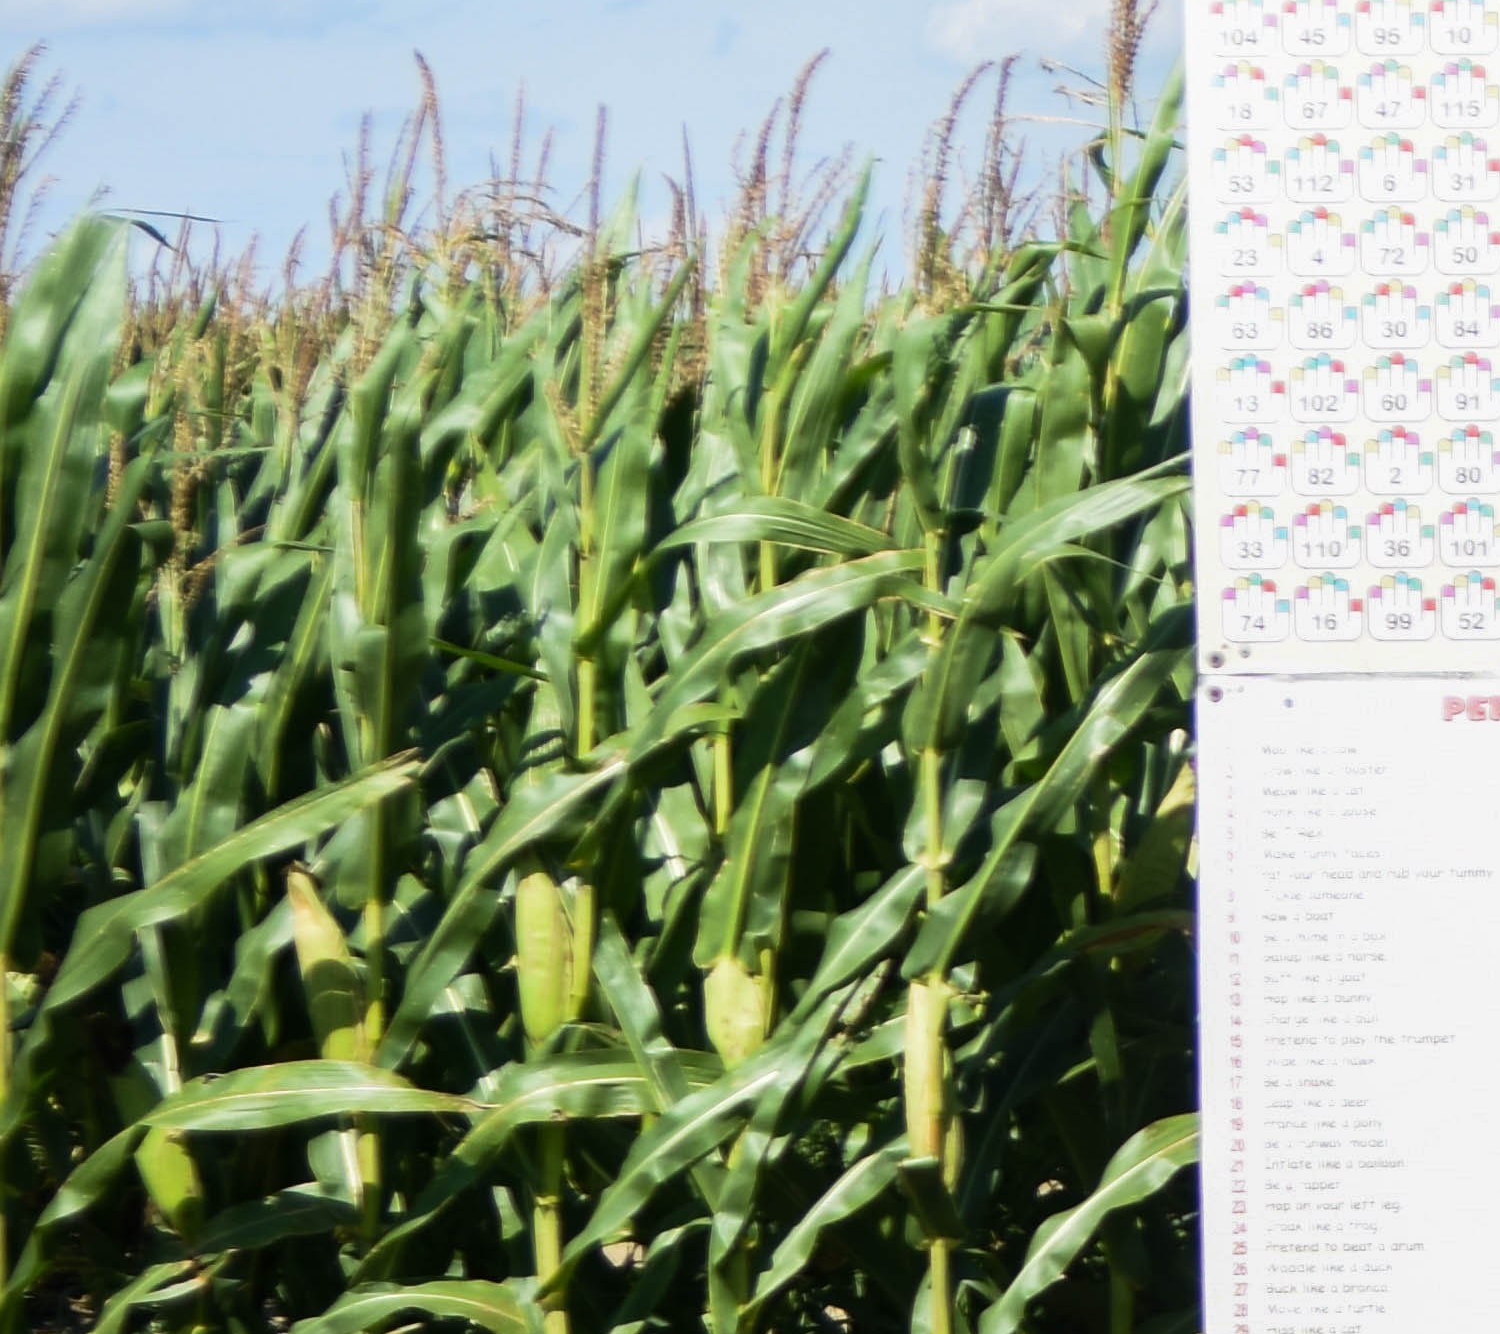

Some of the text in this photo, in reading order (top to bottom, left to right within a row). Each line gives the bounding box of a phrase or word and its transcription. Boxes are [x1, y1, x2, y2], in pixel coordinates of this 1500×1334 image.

[1230, 175, 1254, 193] 53
[1294, 175, 1333, 192] 112
[1383, 175, 1396, 192] 6
[1451, 173, 1474, 191] 31
[1234, 395, 1259, 412] 13
[1300, 395, 1338, 412] 102
[1382, 395, 1407, 411] 60
[1456, 393, 1479, 410] 91
[1241, 615, 1266, 631] 74
[1312, 614, 1337, 630] 16
[1386, 613, 1412, 630] 99
[1459, 613, 1485, 630] 52
